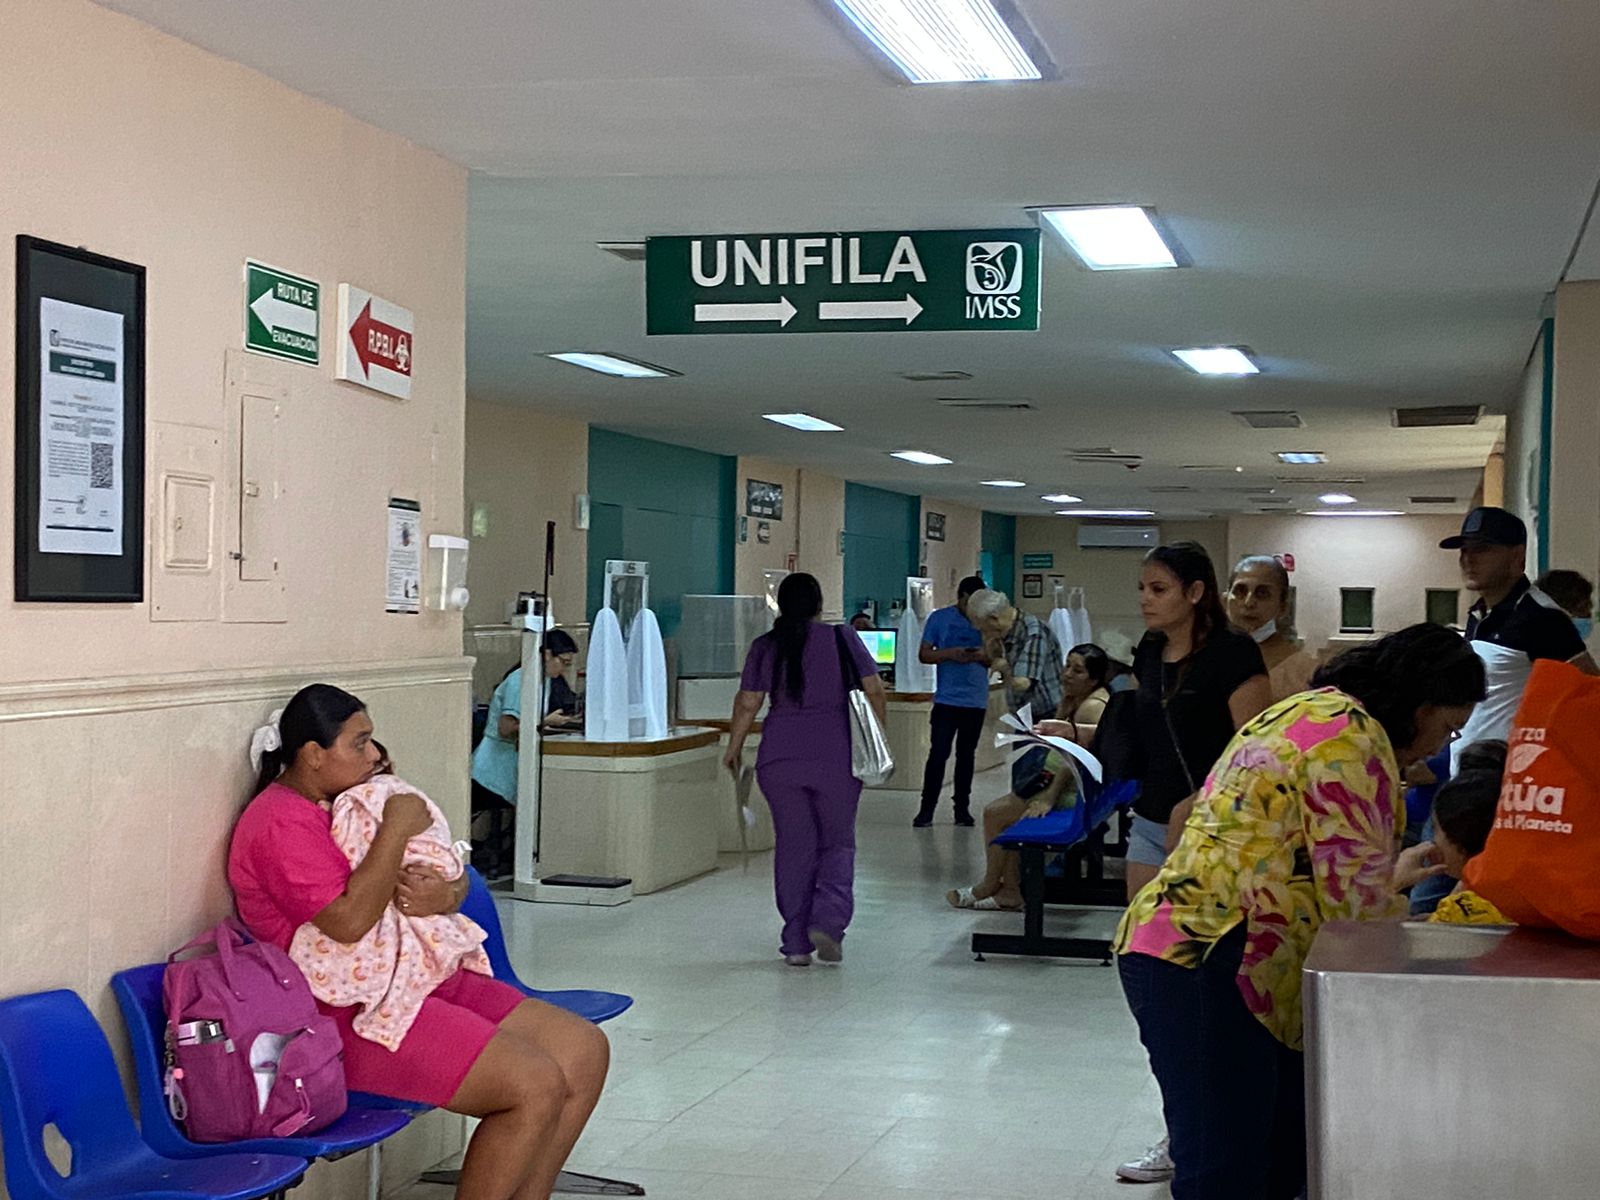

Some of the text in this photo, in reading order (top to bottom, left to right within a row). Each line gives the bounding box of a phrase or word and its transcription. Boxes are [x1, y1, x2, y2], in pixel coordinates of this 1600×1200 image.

[691, 236, 927, 287] UNIFILA
[277, 282, 314, 307] RUTA DE
[965, 295, 1021, 320] IMSS
[1514, 814, 1573, 834] Planeta
